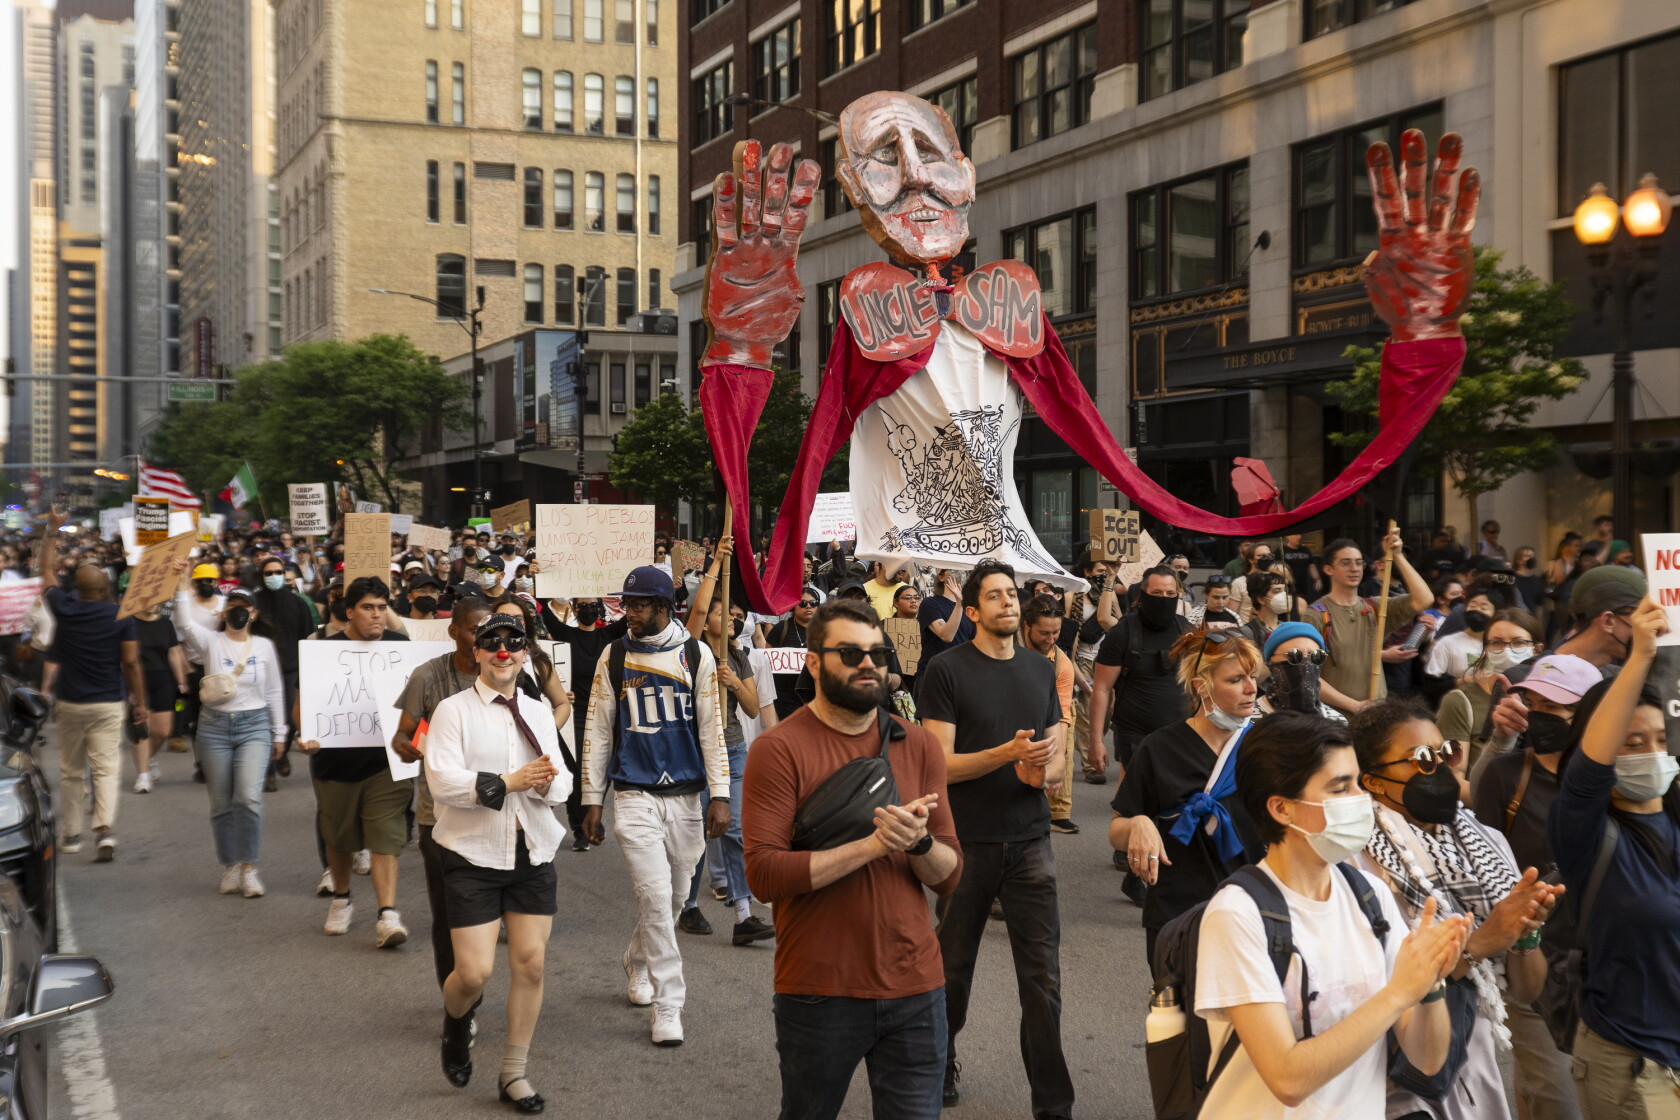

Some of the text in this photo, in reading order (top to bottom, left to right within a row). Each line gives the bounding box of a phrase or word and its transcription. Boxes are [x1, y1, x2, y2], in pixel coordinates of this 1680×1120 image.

[841, 266, 1041, 352] UNCLE SAM
[1223, 347, 1296, 369] THE BOYCE
[137, 507, 166, 516] Trump
[539, 507, 571, 527] LOS
[586, 506, 654, 525] PUEBLOS
[135, 521, 167, 530] Regime
[345, 518, 388, 534] ICE
[1104, 515, 1138, 535] ICE
[355, 536, 375, 550] IS
[541, 531, 653, 548] UNIDOS JAMAS
[1107, 537, 1137, 556] OUT
[347, 552, 389, 569] EVIL
[539, 569, 624, 583] TU LUCHA ES
[338, 650, 402, 675] STOP
[327, 676, 376, 706] MA
[625, 685, 693, 734] Lite
